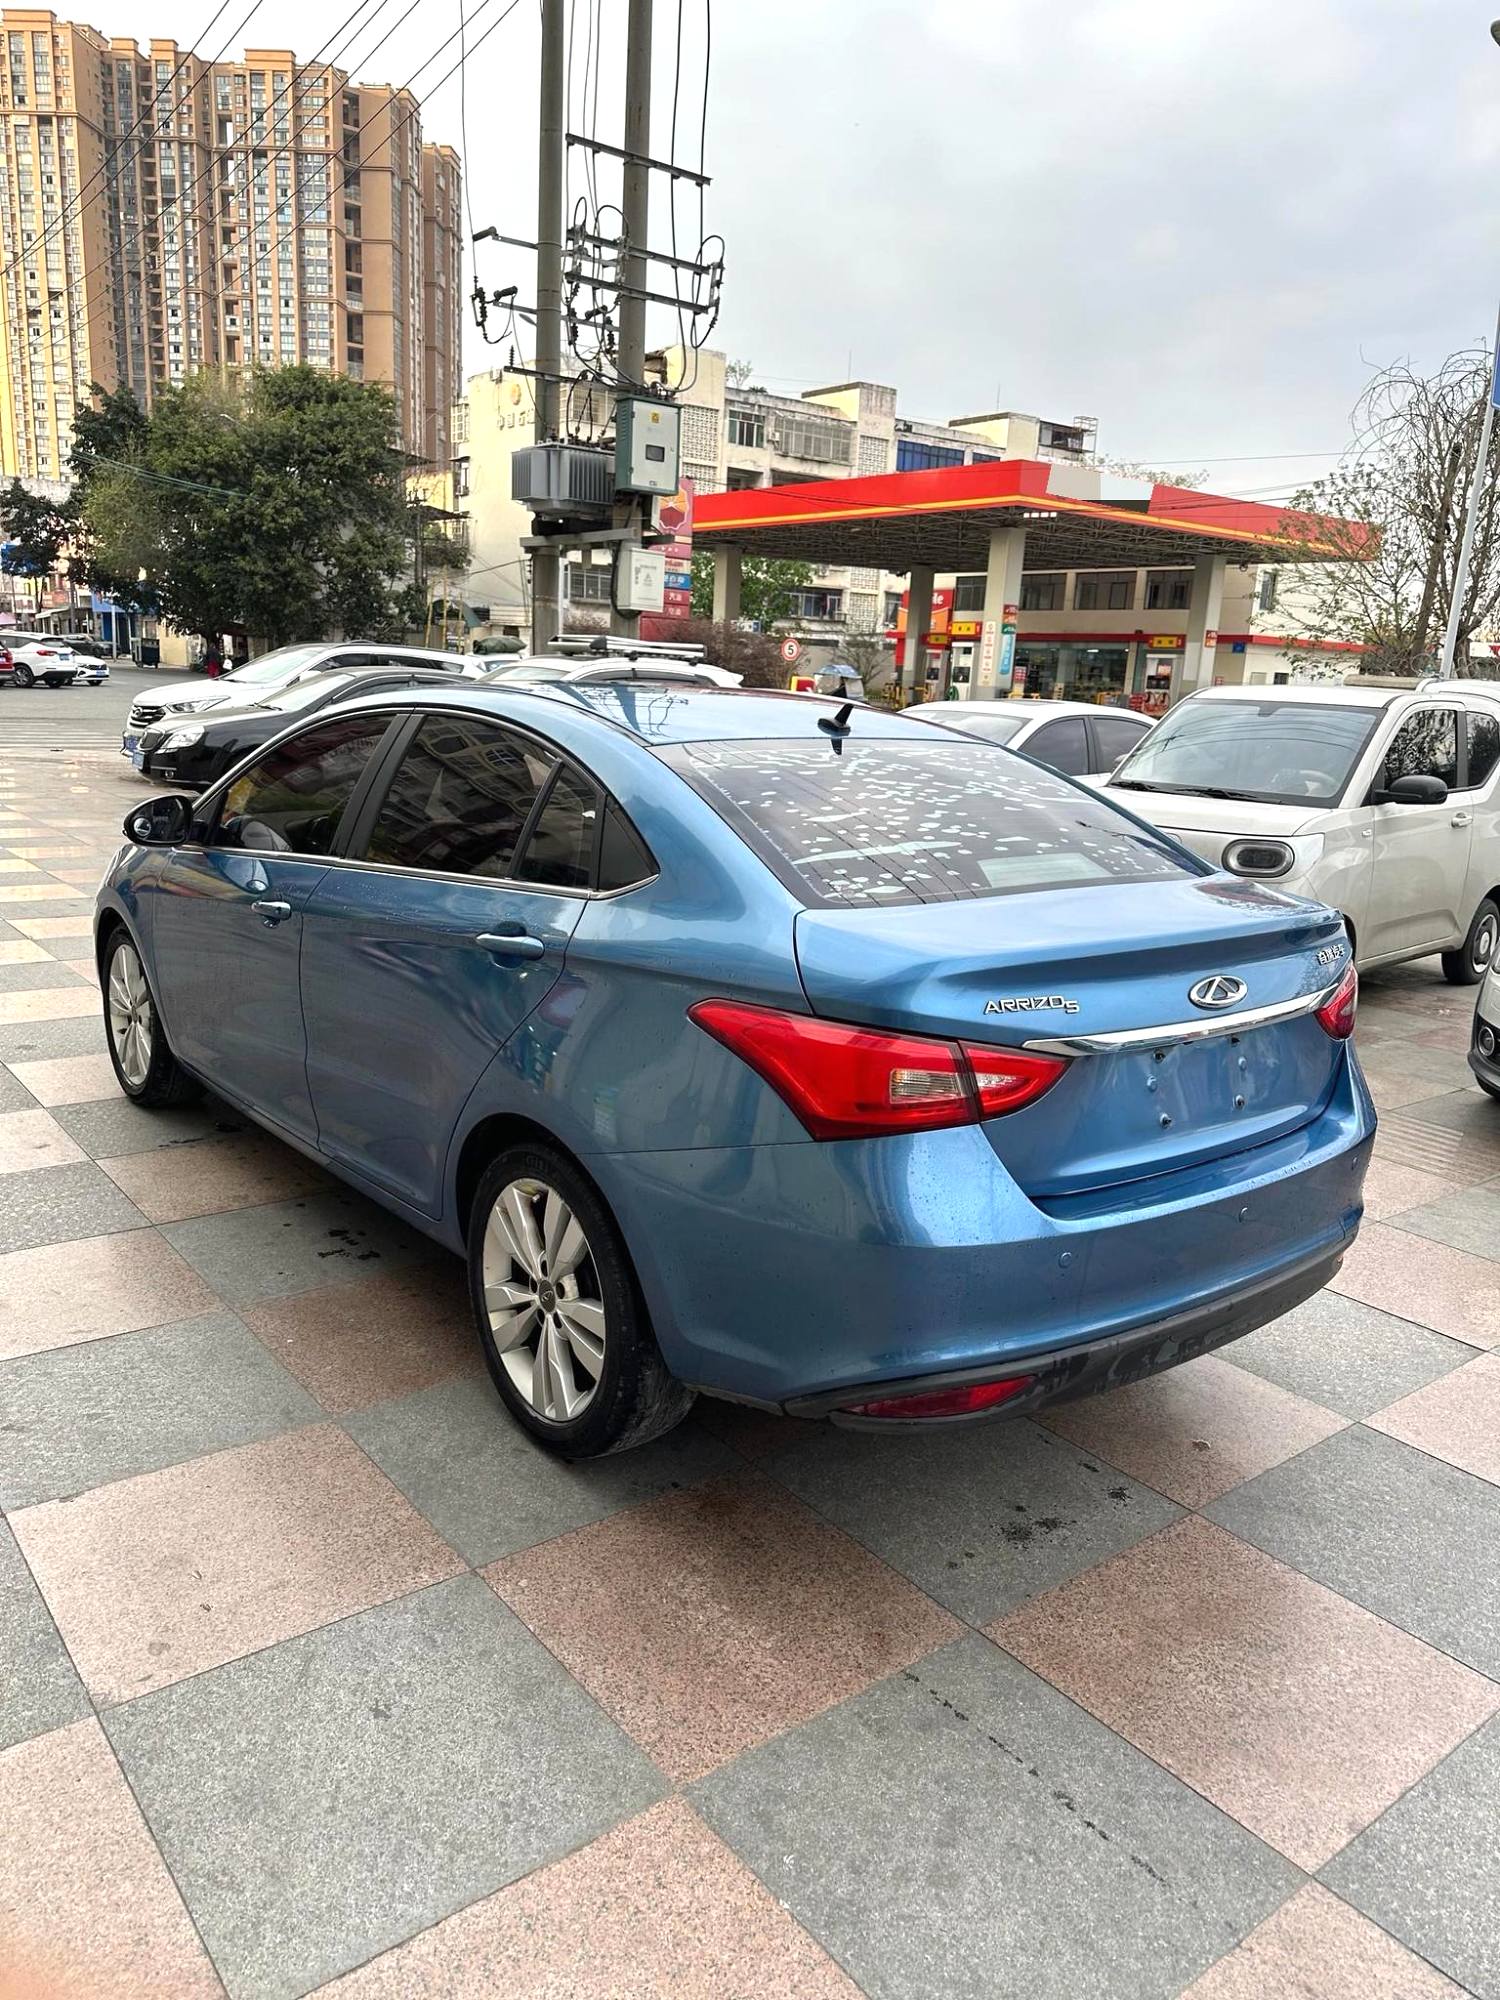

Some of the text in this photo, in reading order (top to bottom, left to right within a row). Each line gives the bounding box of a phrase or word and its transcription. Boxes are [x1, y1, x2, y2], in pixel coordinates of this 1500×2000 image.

[787, 644, 794, 655] 5
[1315, 943, 1345, 966] 奇瑞汽车
